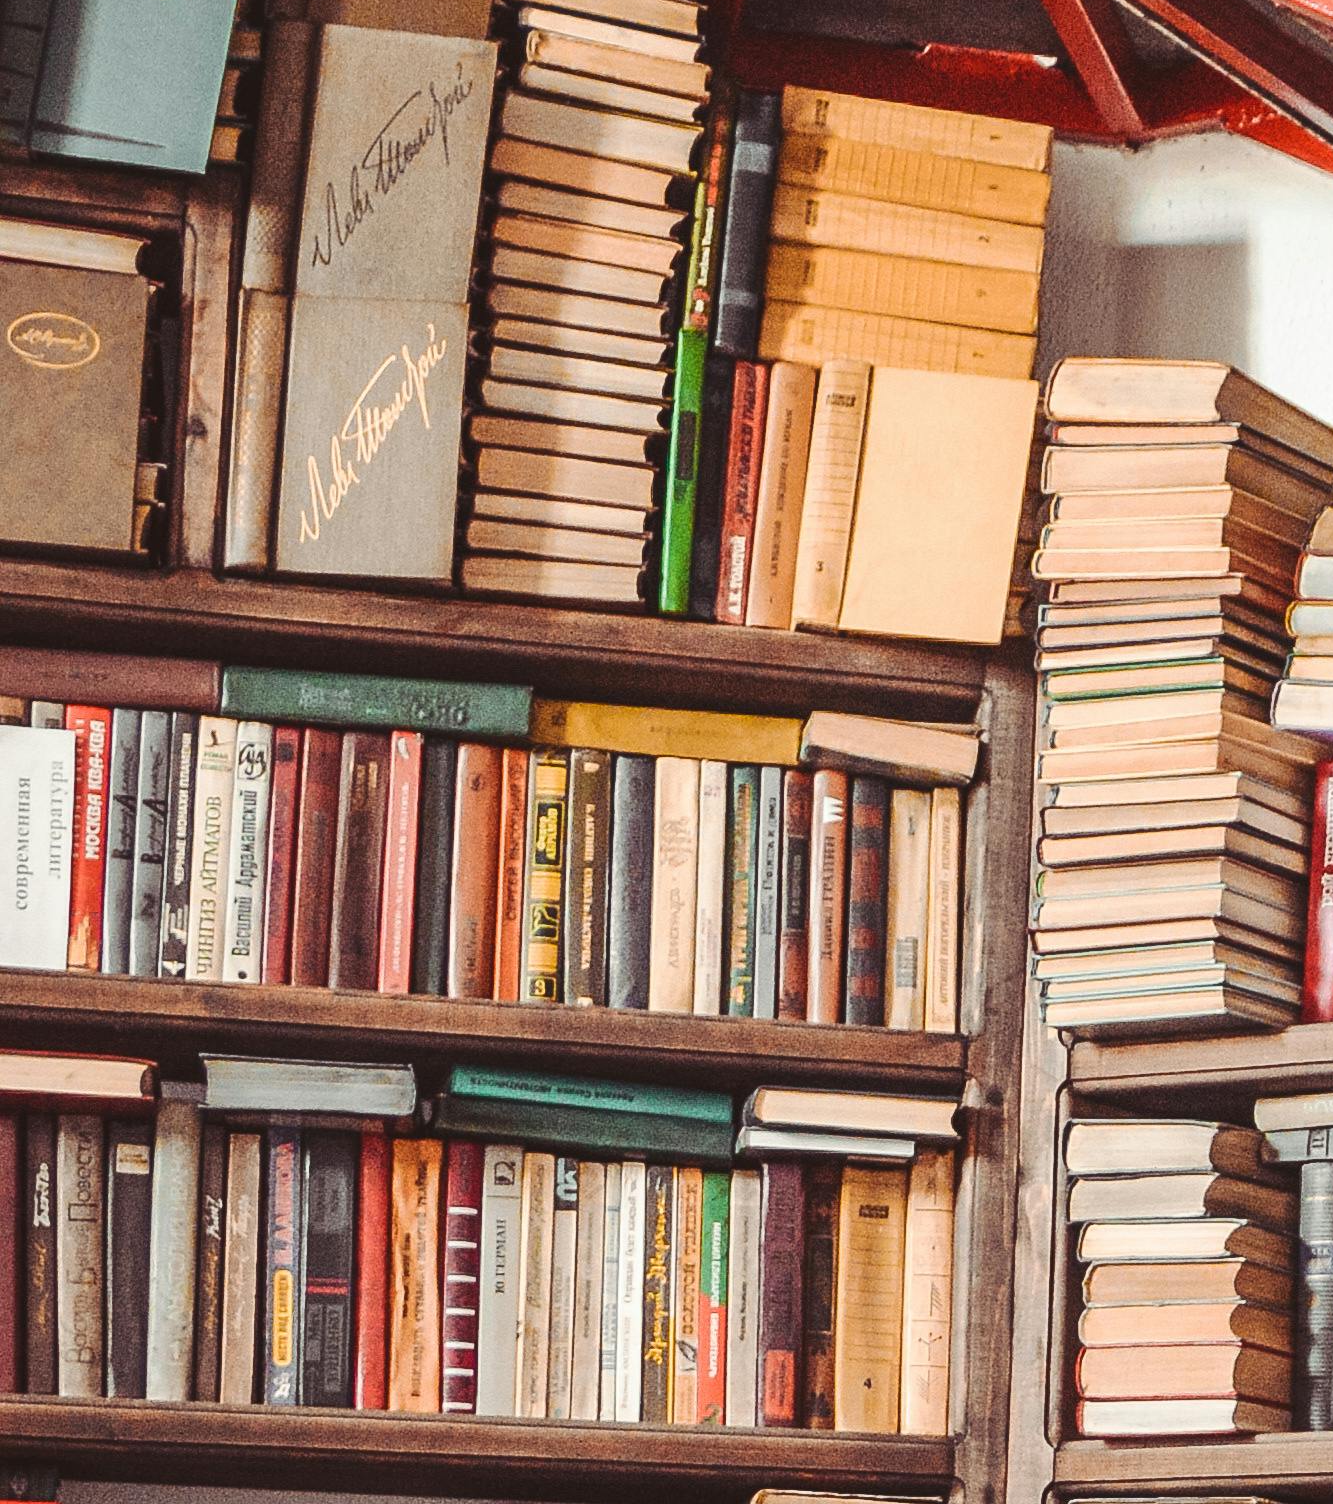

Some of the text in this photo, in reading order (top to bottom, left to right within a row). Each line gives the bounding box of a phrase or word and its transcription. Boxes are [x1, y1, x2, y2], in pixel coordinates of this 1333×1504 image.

[15, 777, 33, 910] современная
[48, 760, 68, 879] литература
[85, 720, 104, 860] МОСКВА КВА-КВА
[198, 796, 221, 974] ЧИНГИЗ АЙТМАТОВ
[232, 789, 264, 957] Василий Ардаматский
[495, 1219, 507, 1276] ГЕРМАН
